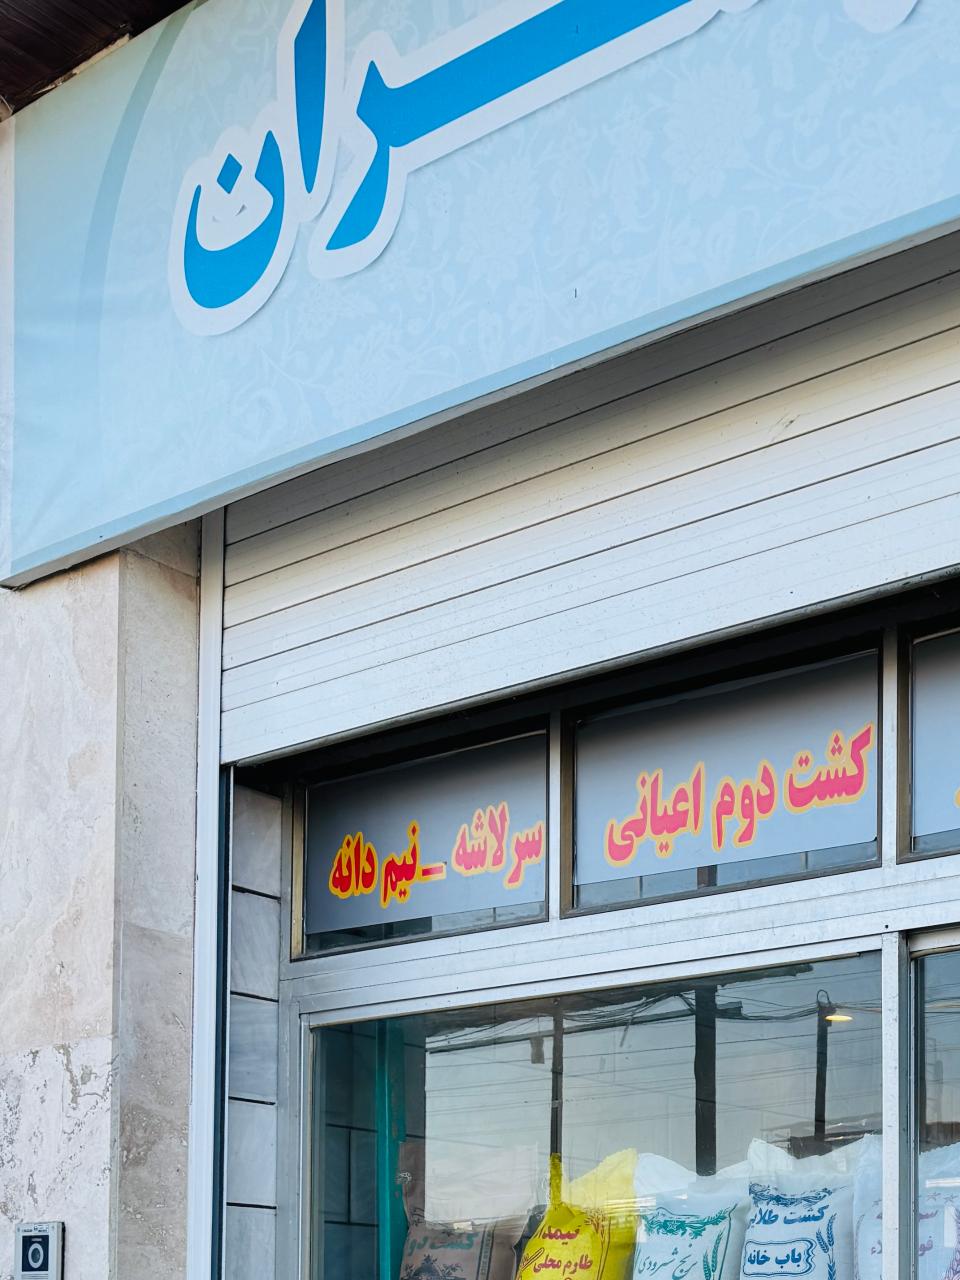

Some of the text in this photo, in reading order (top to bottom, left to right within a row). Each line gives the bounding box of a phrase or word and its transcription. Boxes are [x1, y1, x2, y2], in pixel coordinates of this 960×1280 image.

[606, 723, 873, 864] کشت دوم اعیانی
[330, 835, 377, 897] دانه
[782, 1204, 830, 1226] کشت
[533, 1253, 593, 1276] طارم محلی
[746, 1247, 802, 1269] باب خانه
